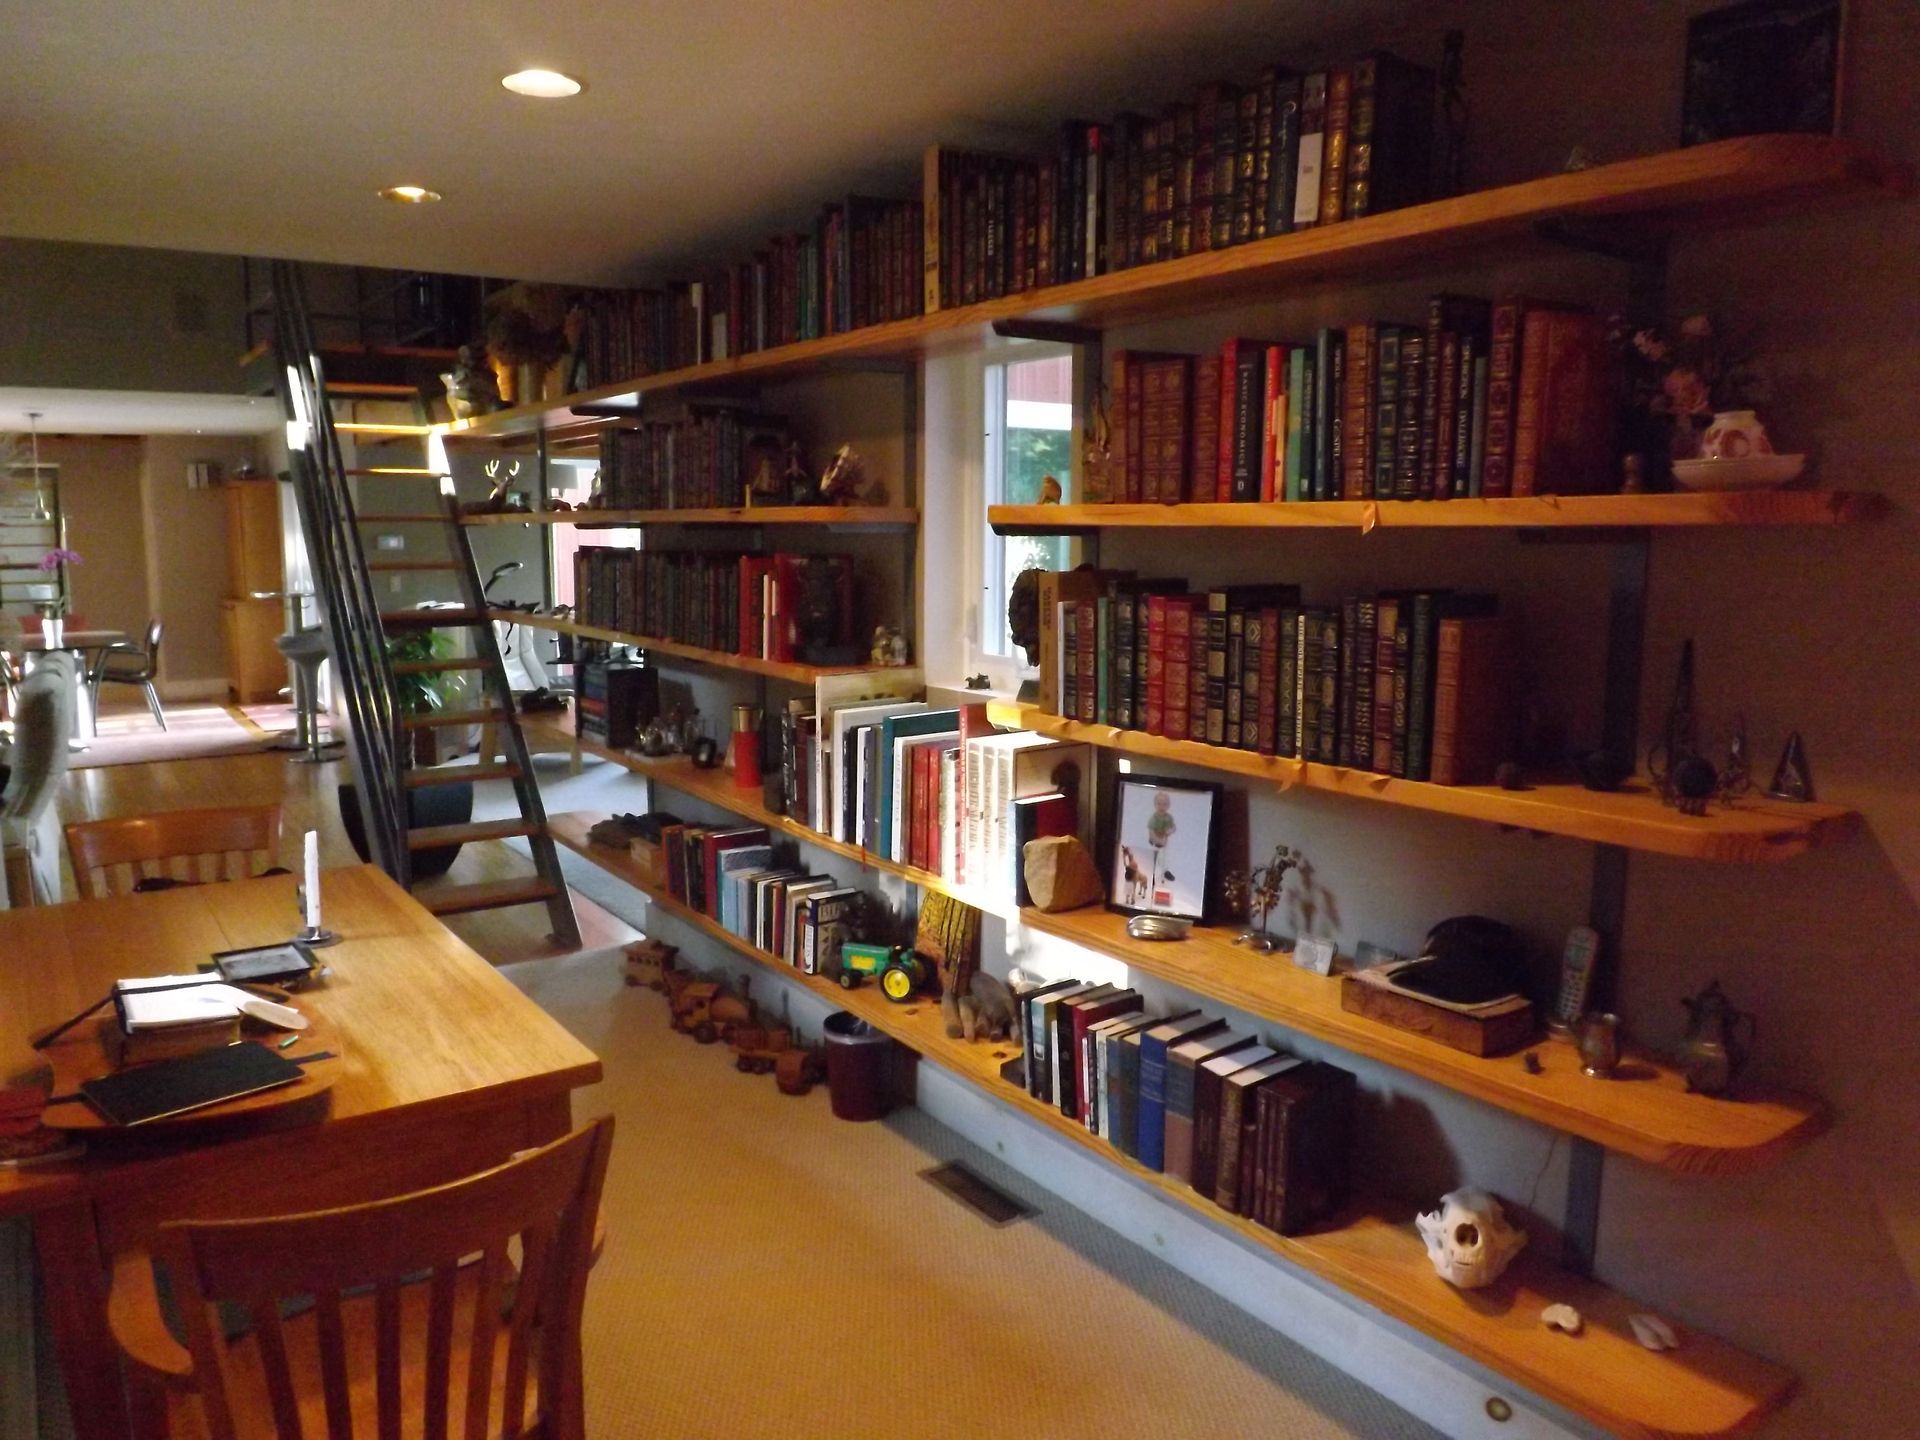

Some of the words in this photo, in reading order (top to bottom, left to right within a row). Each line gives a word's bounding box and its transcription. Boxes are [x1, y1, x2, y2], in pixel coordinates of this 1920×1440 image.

[1240, 371, 1248, 401] BASIC
[1238, 404, 1247, 465] ECONOMICS
[1332, 418, 1343, 458] GOSPEL
